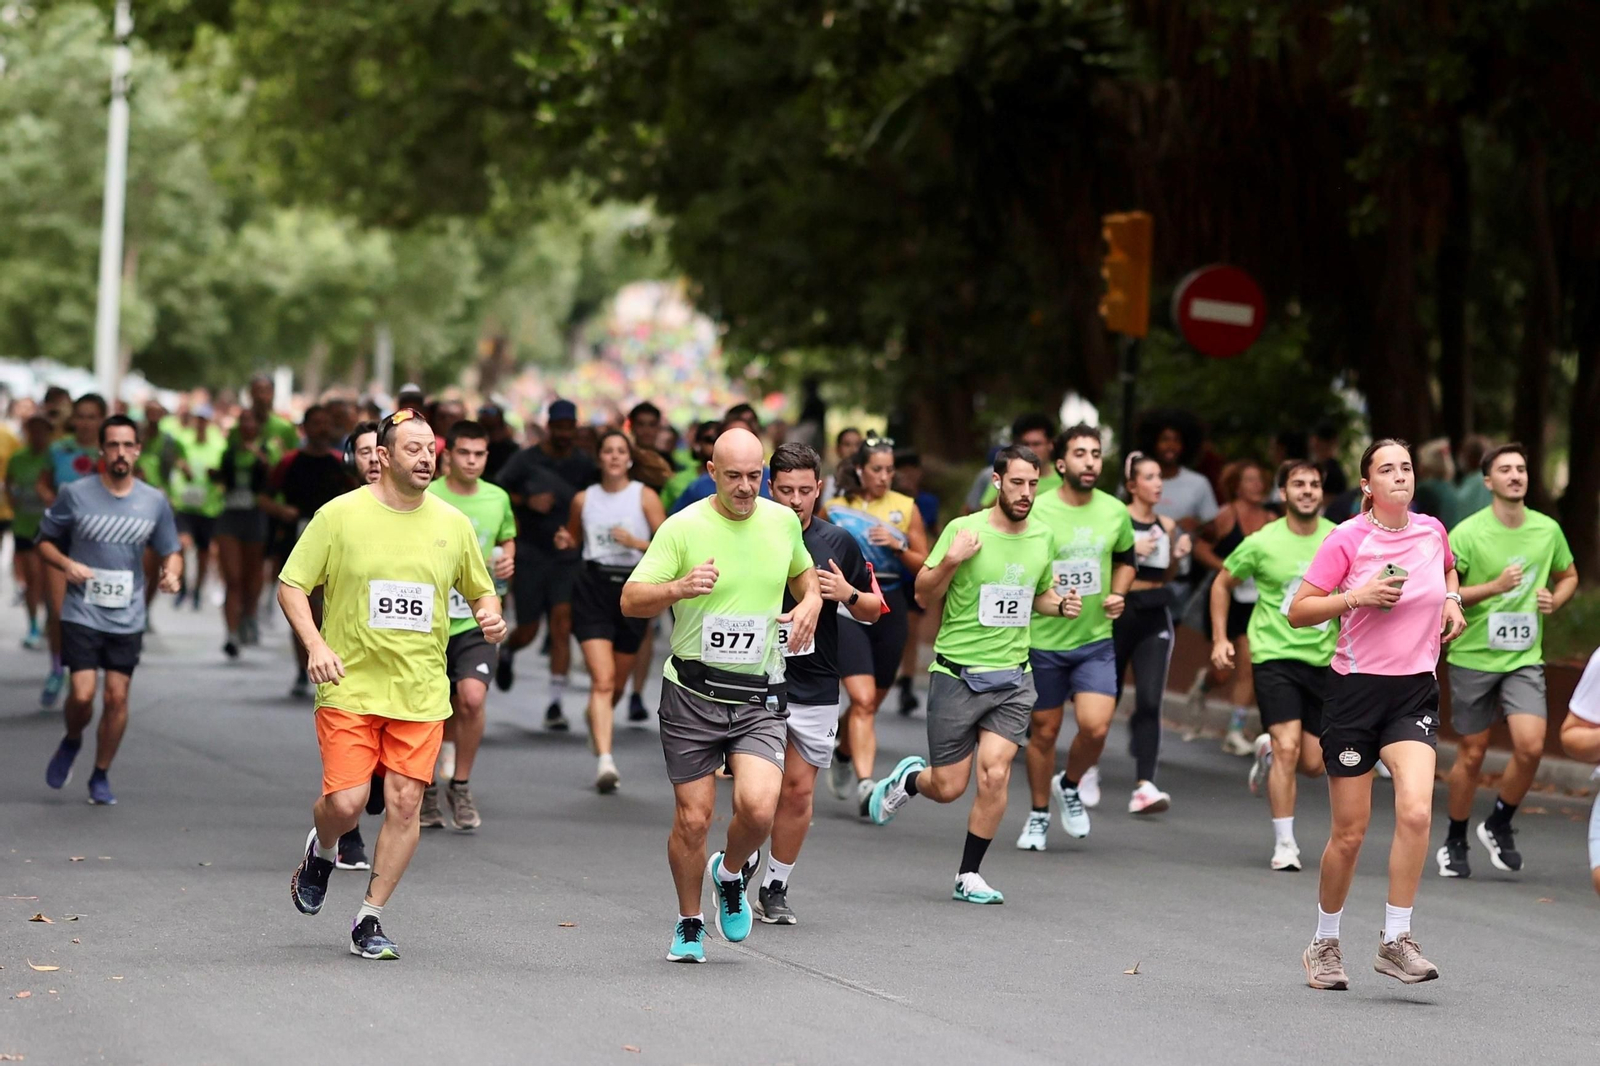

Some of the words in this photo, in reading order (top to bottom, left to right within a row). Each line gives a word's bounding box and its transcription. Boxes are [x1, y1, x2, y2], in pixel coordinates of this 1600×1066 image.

[92, 582, 124, 596] 532
[379, 597, 423, 617] 936
[995, 600, 1018, 614] 12
[1496, 626, 1530, 639] 413
[710, 631, 755, 650] 977
